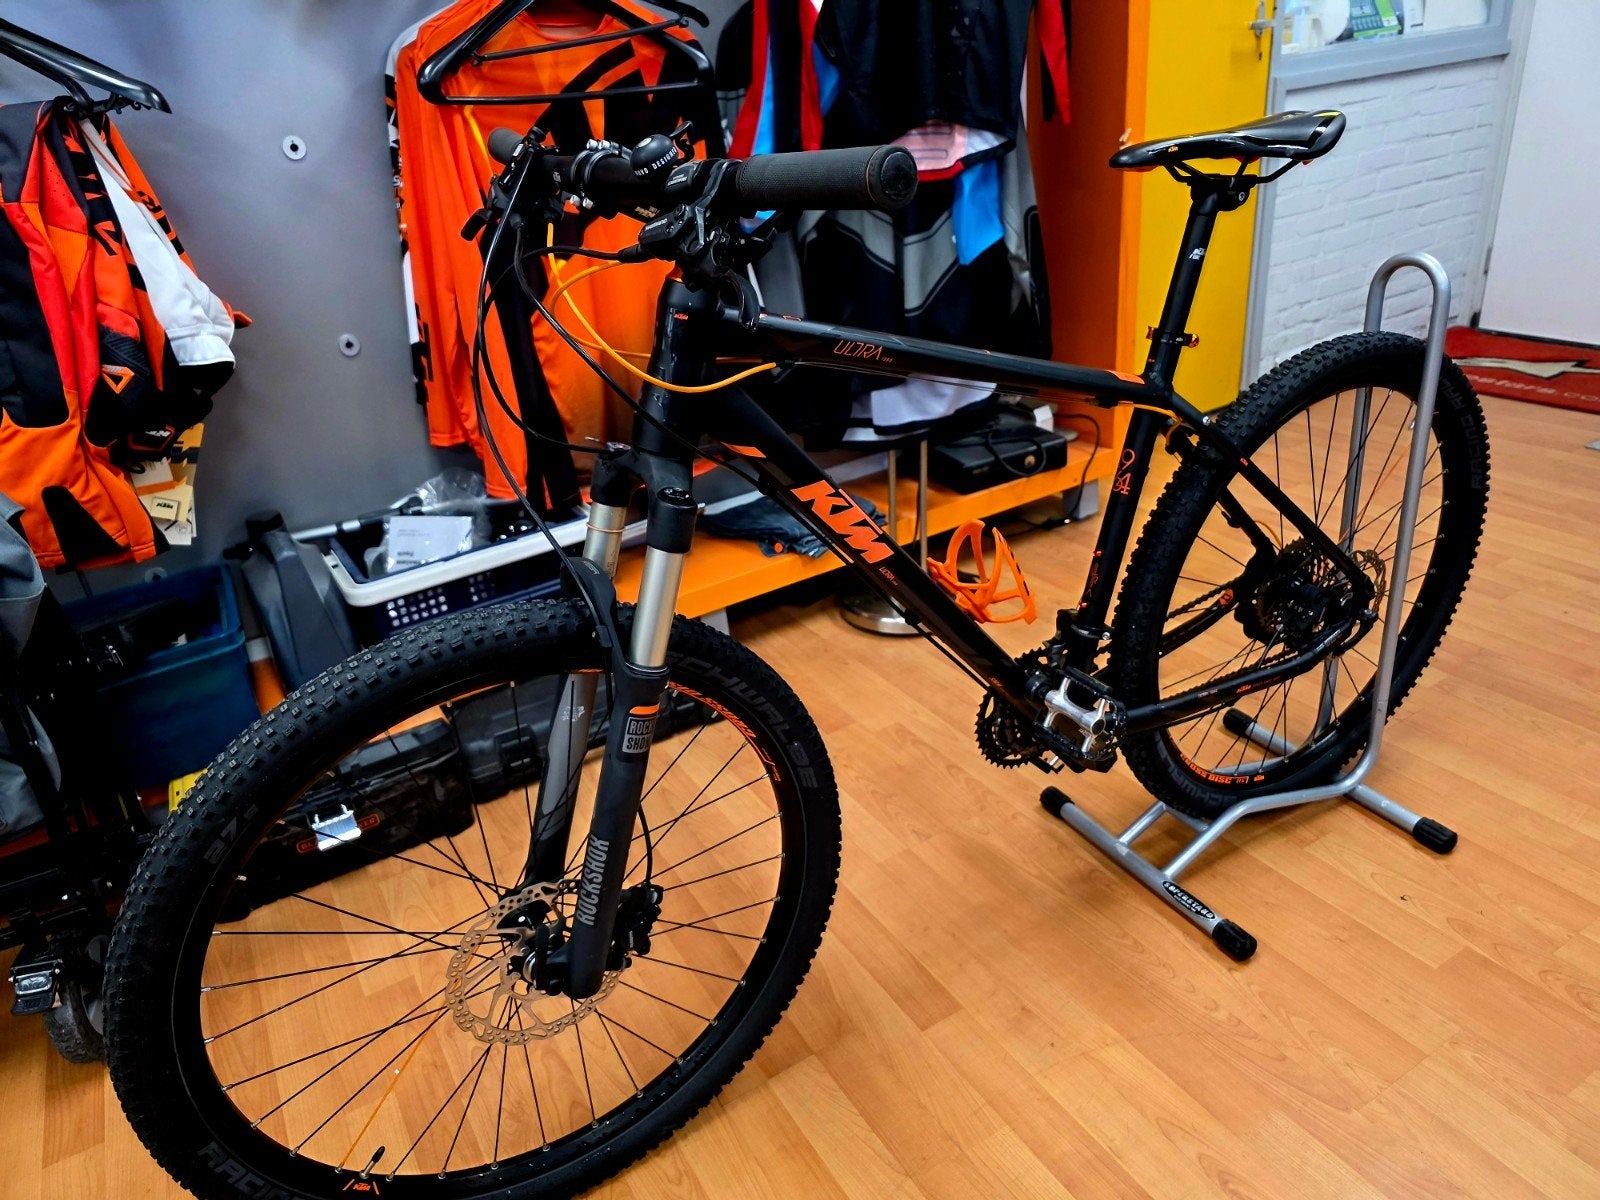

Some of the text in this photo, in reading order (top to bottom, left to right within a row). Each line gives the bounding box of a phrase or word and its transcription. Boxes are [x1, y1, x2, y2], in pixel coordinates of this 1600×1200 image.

[832, 339, 884, 361] ULTRA
[790, 479, 896, 564] KTM
[576, 834, 610, 926] ROCKSHOX
